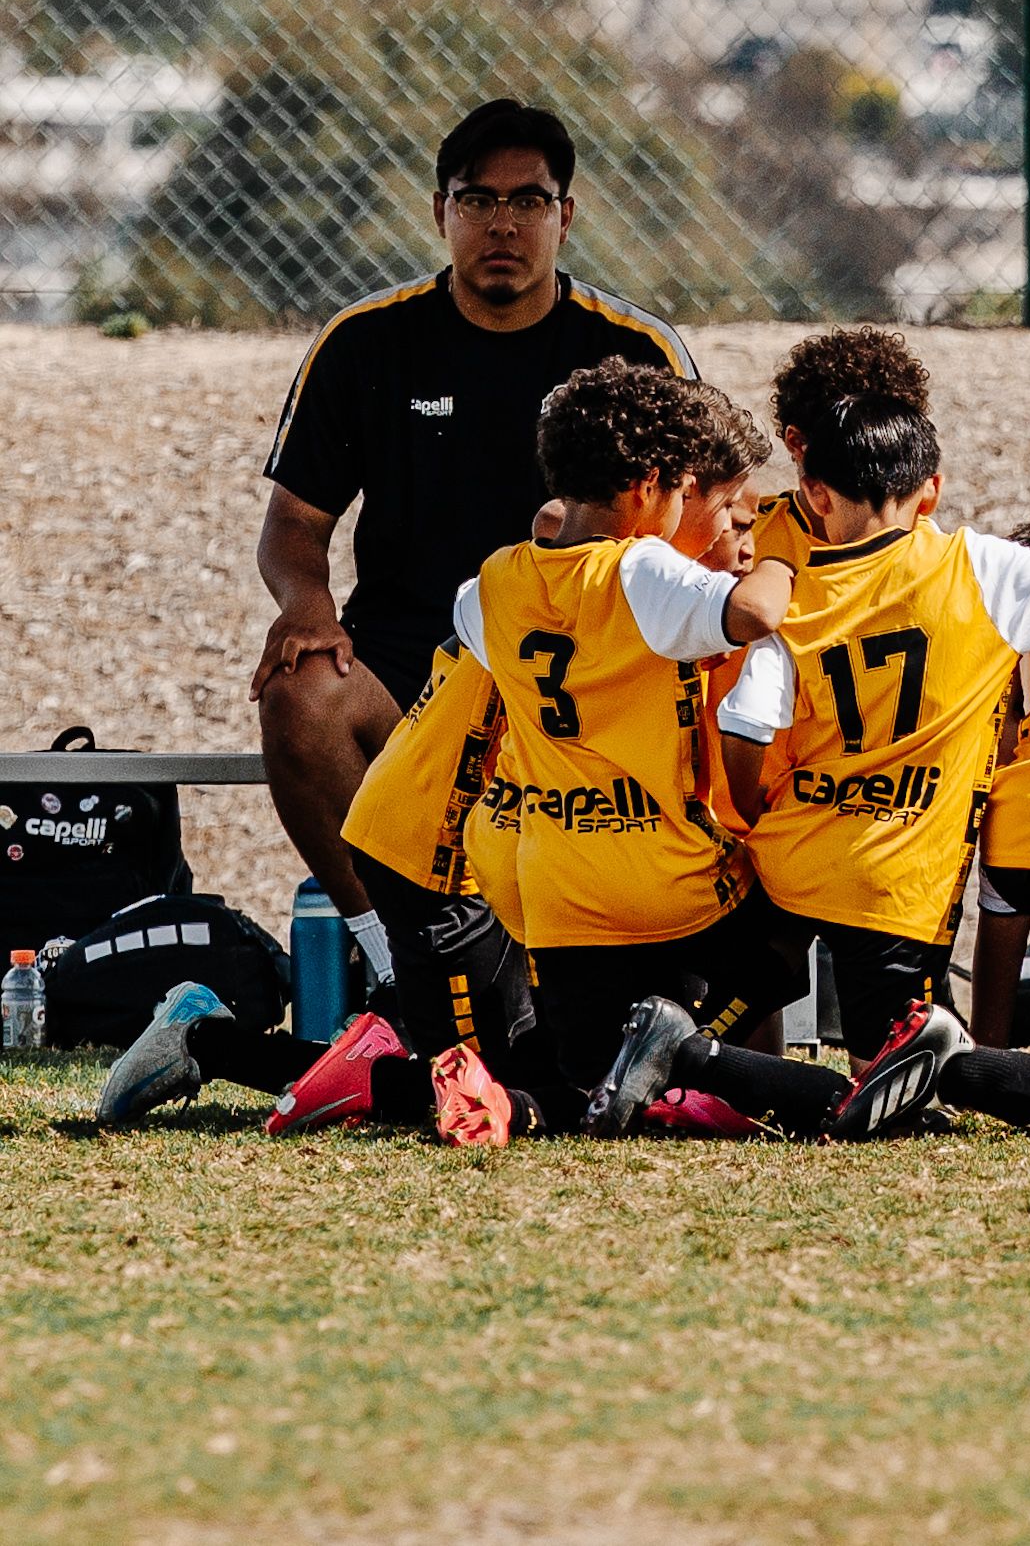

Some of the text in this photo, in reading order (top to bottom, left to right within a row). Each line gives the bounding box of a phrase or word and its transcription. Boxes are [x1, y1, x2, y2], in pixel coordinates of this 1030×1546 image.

[519, 628, 584, 739] 3
[818, 625, 931, 755] 17
[793, 765, 941, 810] capelli
[25, 817, 107, 843] capelli
[577, 816, 662, 834] SPORT
[836, 803, 923, 826] SPORT
